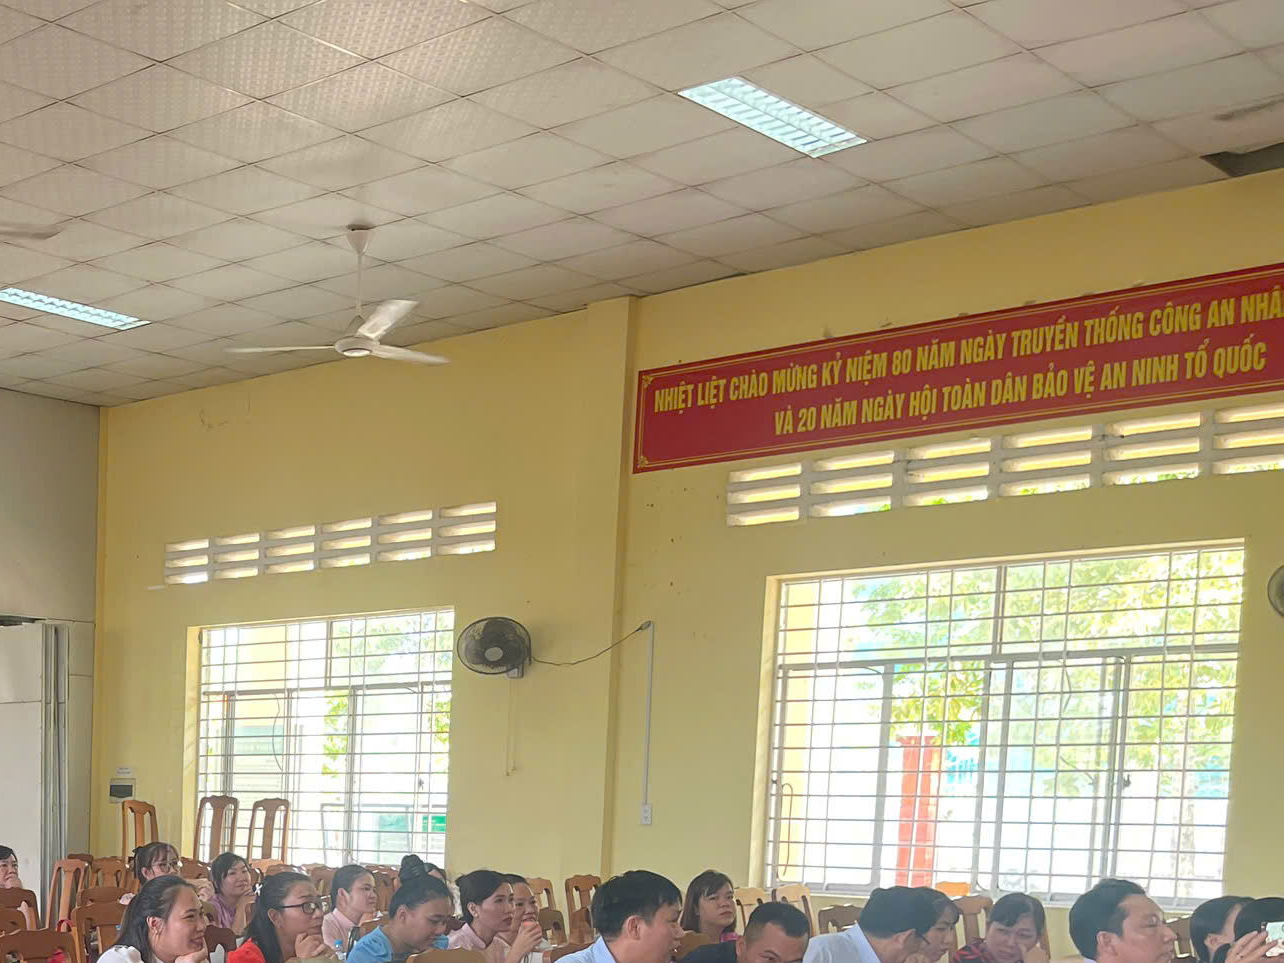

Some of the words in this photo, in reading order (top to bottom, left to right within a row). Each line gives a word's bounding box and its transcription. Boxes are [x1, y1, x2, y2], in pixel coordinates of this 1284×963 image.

[654, 380, 695, 415] NHIỆT
[697, 375, 727, 409] LIỆT
[729, 368, 769, 401] CHÀO
[772, 362, 818, 395] MỪNG
[821, 351, 843, 387] KỶ
[845, 349, 889, 386] NIỆM
[891, 348, 913, 376] 80
[916, 338, 956, 372] NĂM
[959, 329, 1007, 366] NGÀY
[1011, 314, 1080, 358] TRUYỀN
[1084, 305, 1145, 347] THỐNG
[1149, 300, 1202, 337] CÔNG
[1206, 297, 1236, 329] AN
[1240, 285, 1284, 324] NHÂ
[774, 404, 794, 436] VÀ
[797, 406, 817, 433] 20
[820, 396, 858, 430] NĂM
[861, 389, 906, 424] NGÀY
[908, 383, 938, 421] HỘI
[942, 377, 987, 413] TOÀN
[990, 371, 1028, 406] DÂN
[1031, 361, 1069, 400] BẢO
[1073, 359, 1096, 399] VỆ
[1100, 360, 1127, 391] AN
[1131, 353, 1179, 387] NINH
[1184, 337, 1210, 380] TỔ
[1212, 333, 1268, 379] QUỐC
